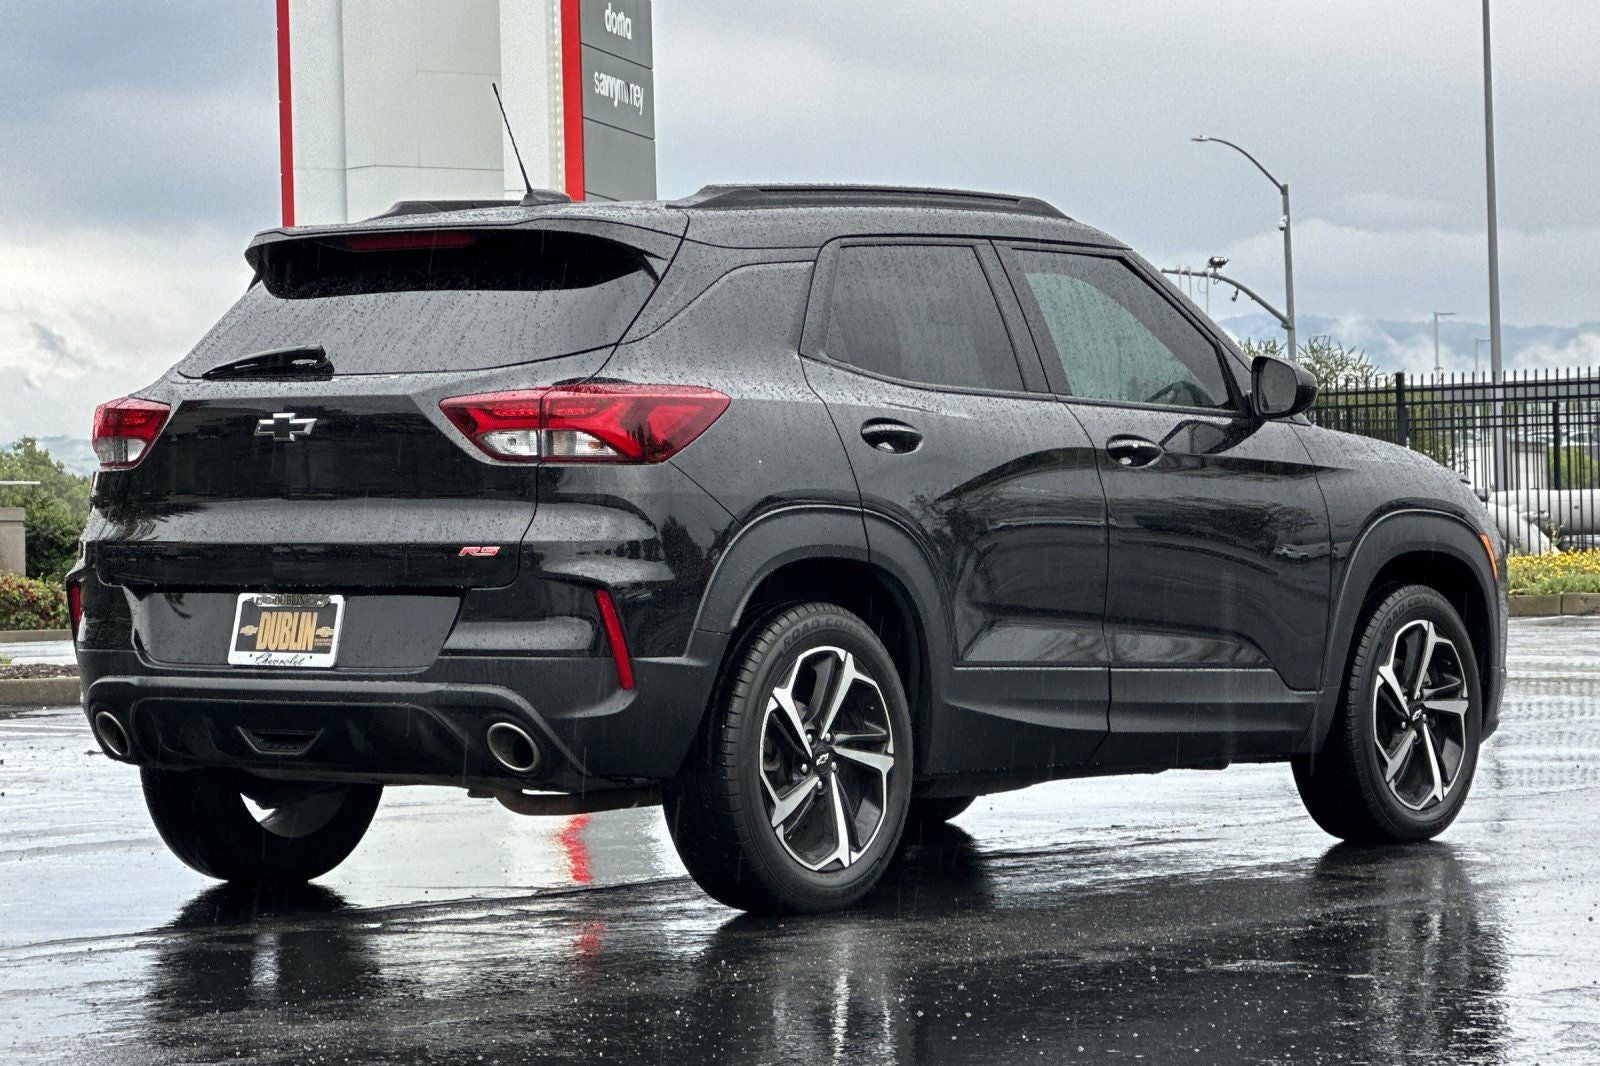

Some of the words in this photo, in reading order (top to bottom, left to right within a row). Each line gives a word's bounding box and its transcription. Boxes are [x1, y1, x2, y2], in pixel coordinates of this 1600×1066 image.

[604, 2, 632, 40] doma
[458, 546, 501, 557] RS
[256, 611, 318, 651] DUBLIN
